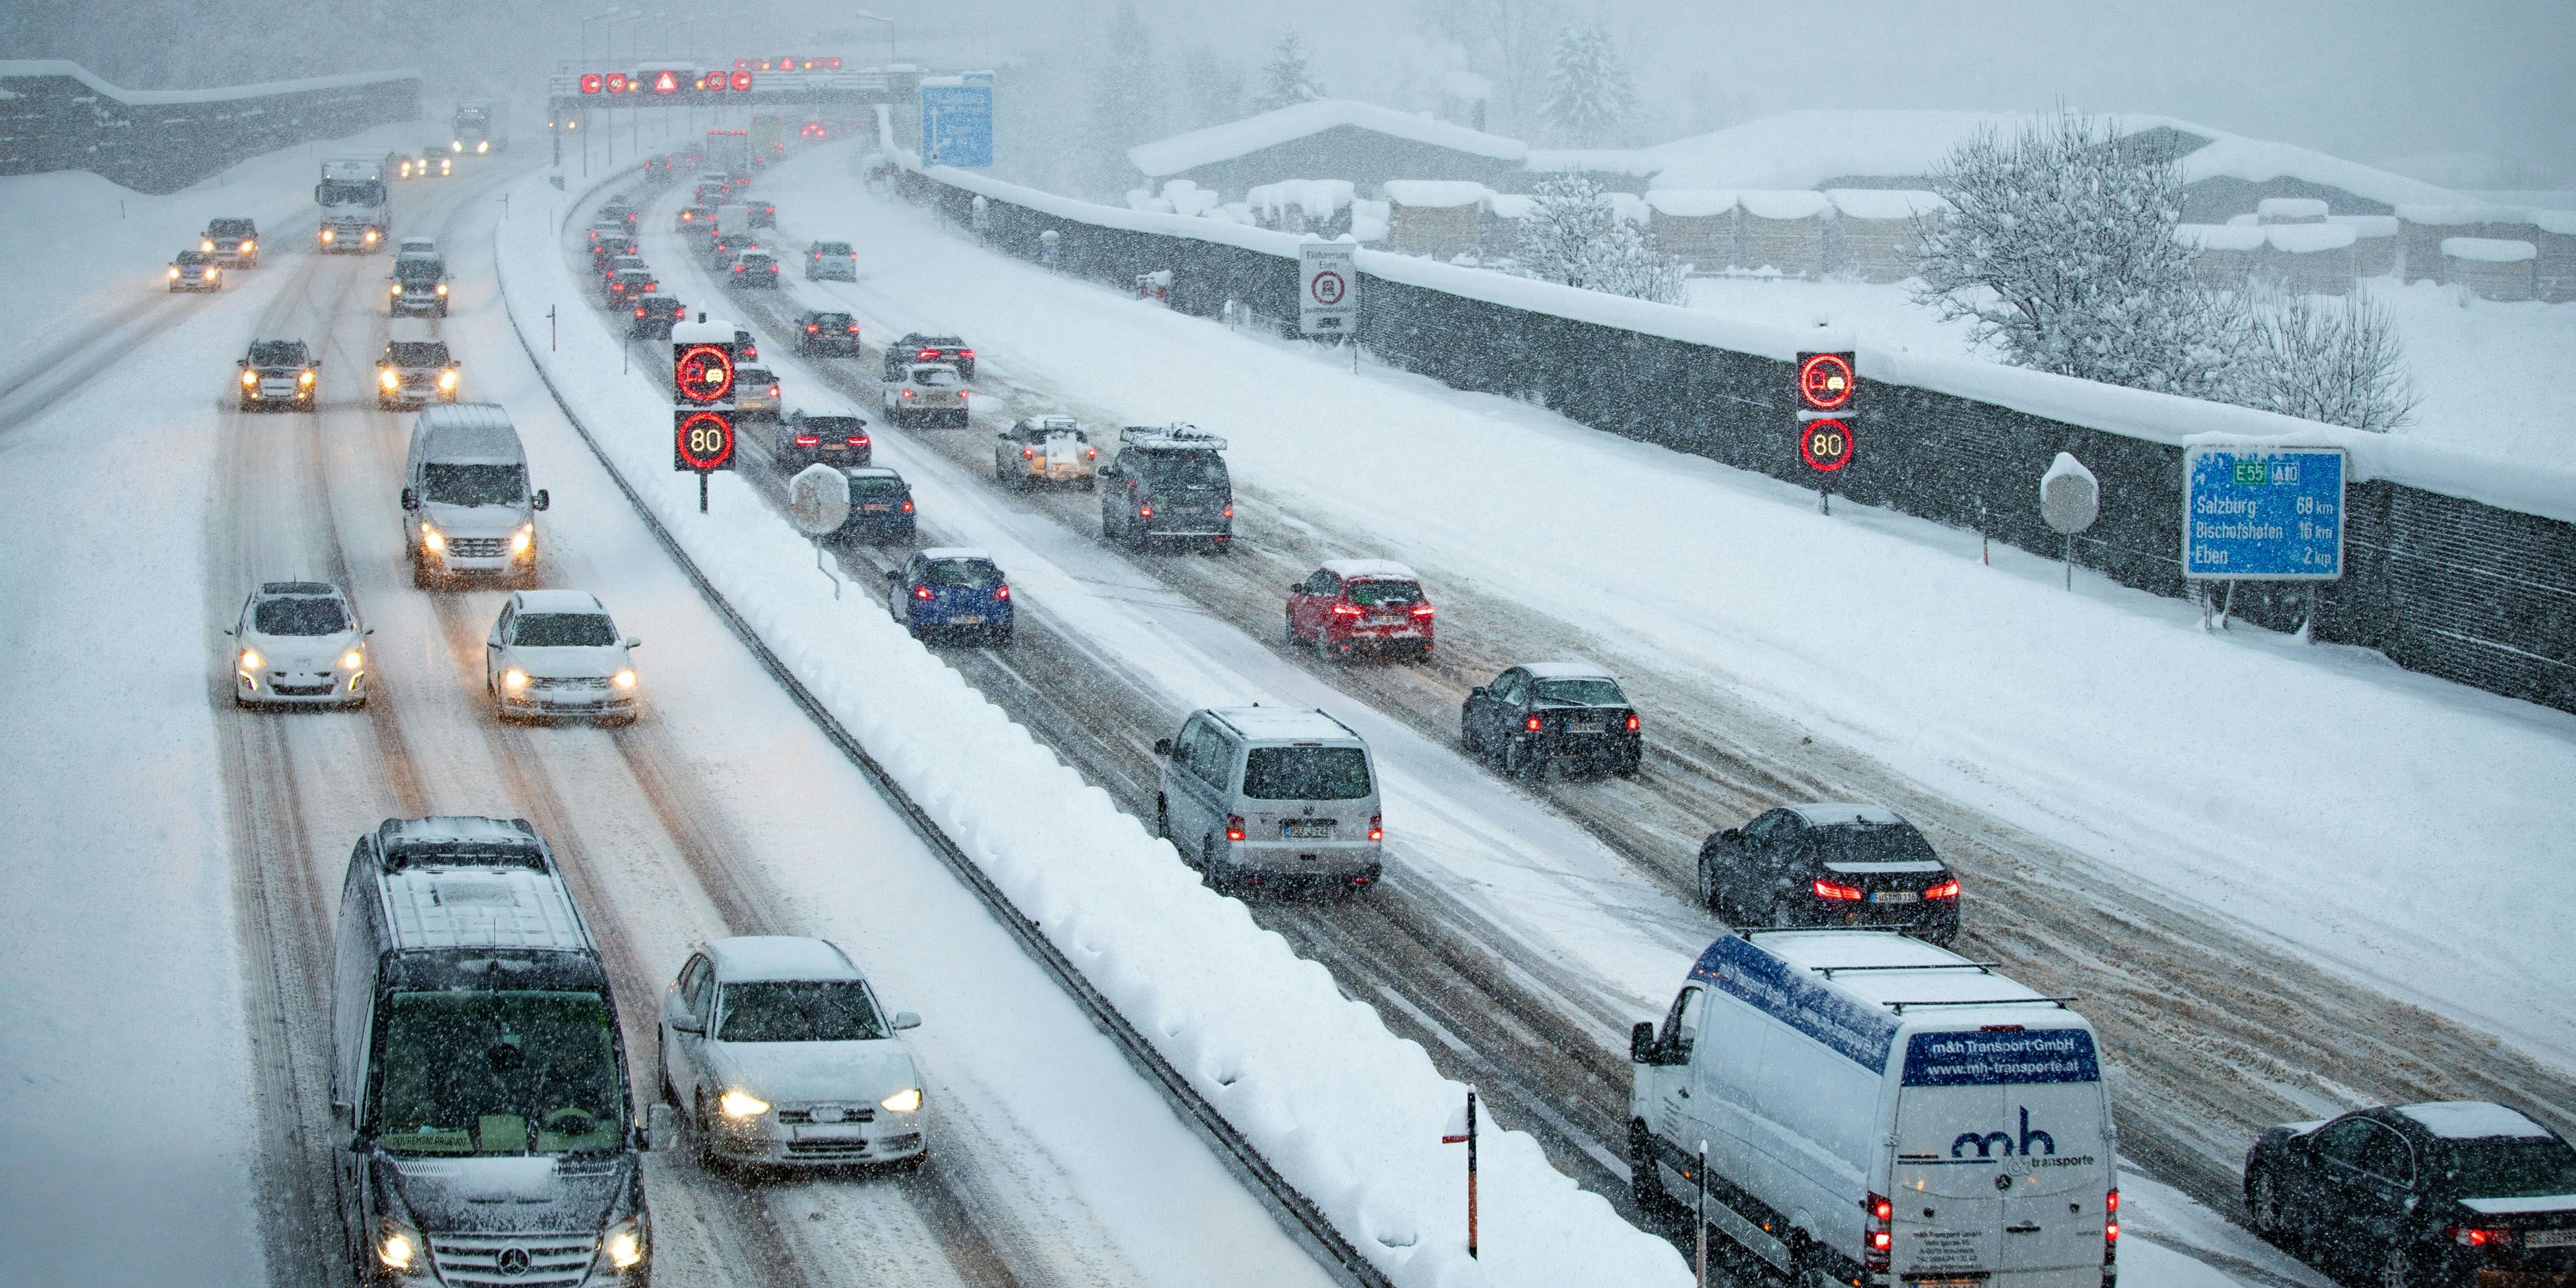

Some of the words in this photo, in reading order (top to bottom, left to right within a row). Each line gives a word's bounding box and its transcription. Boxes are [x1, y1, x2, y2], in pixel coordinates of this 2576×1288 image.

[690, 429, 721, 452] 80
[1814, 433, 1842, 456] 80
[2274, 465, 2298, 482] A10
[2196, 495, 2257, 519] Salzburg
[2316, 500, 2334, 515] km
[2195, 521, 2283, 539] Bischofshofen
[2299, 521, 2313, 539] 16
[2316, 525, 2333, 539] km
[2195, 546, 2228, 565] Eben
[2303, 545, 2313, 565] 2
[2315, 550, 2331, 565] km
[1932, 1041, 1965, 1054] m&h
[1964, 1039, 2032, 1054] Transport
[2033, 1038, 2075, 1052] GmbH
[1925, 1059, 2079, 1076] www.mh-transporte.at
[1950, 1105, 2055, 1157] mh
[2031, 1155, 2094, 1168] transporte
